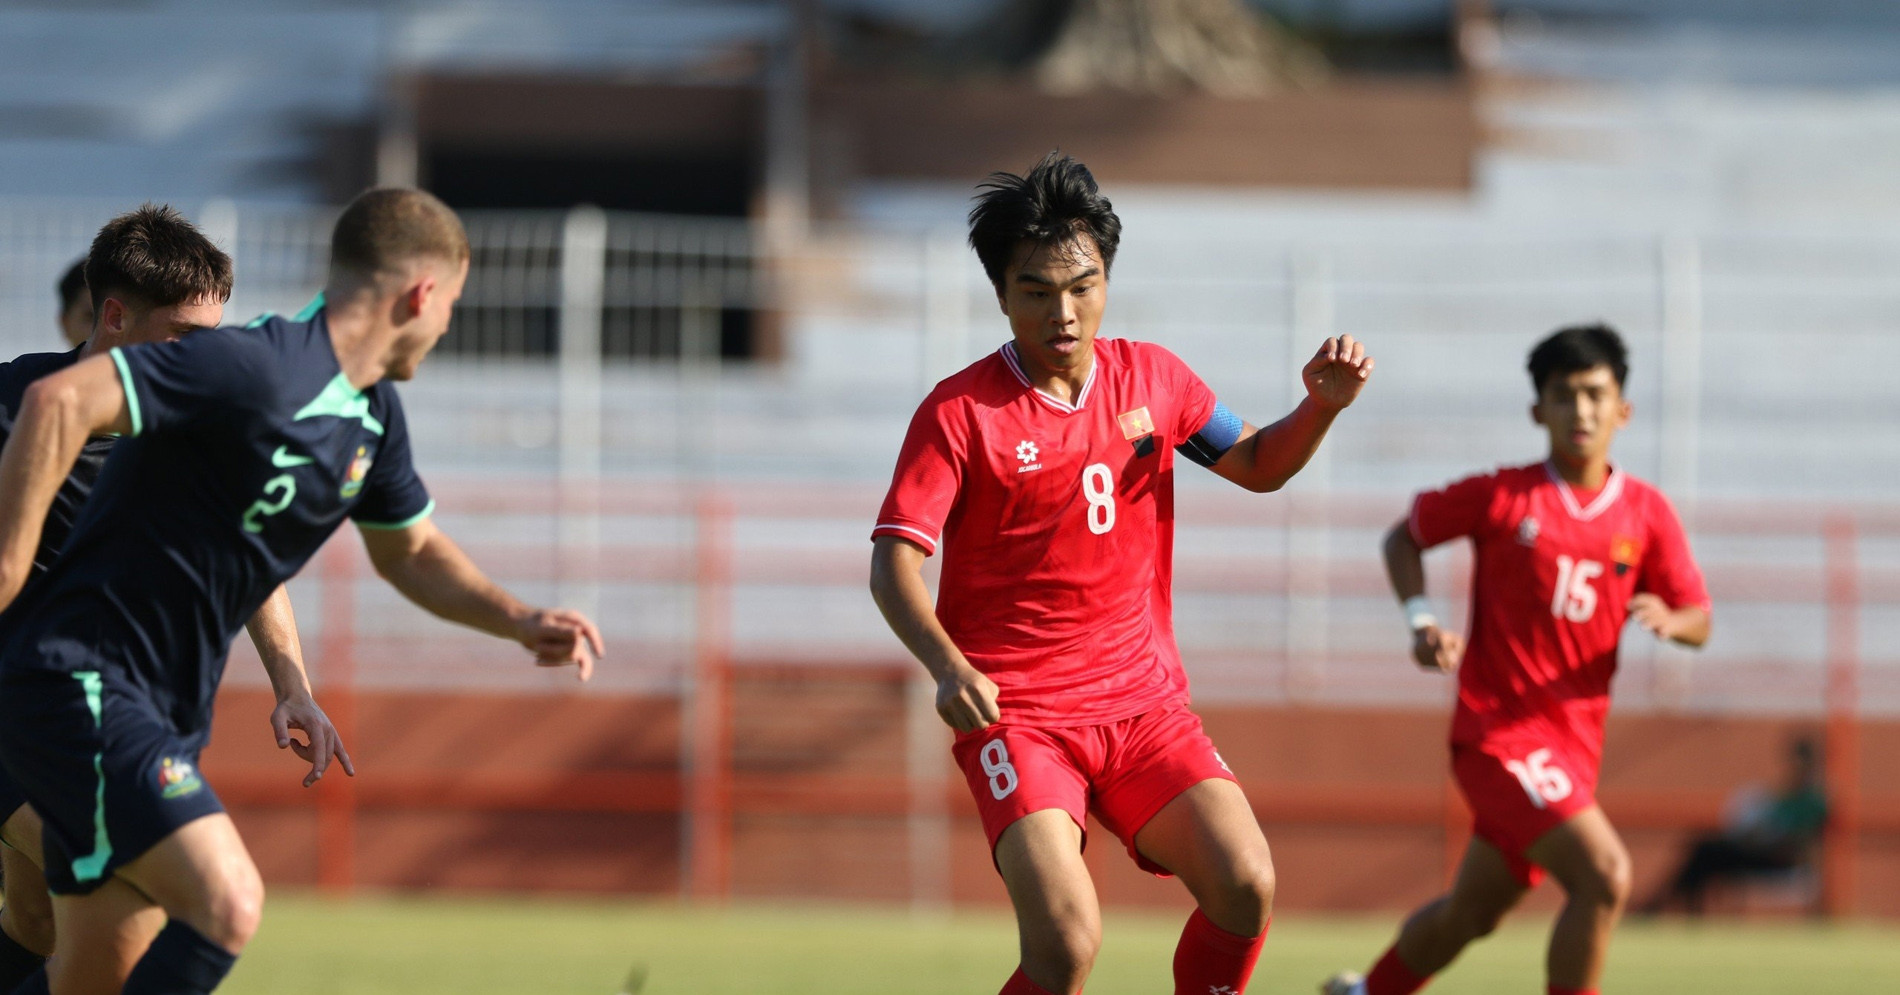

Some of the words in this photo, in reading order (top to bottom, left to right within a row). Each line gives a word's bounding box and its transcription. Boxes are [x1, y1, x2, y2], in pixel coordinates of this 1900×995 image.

[242, 473, 297, 533] 2
[1082, 462, 1115, 534] 8
[1551, 554, 1603, 623] 15
[980, 738, 1018, 801] 8
[1505, 748, 1573, 809] 15
